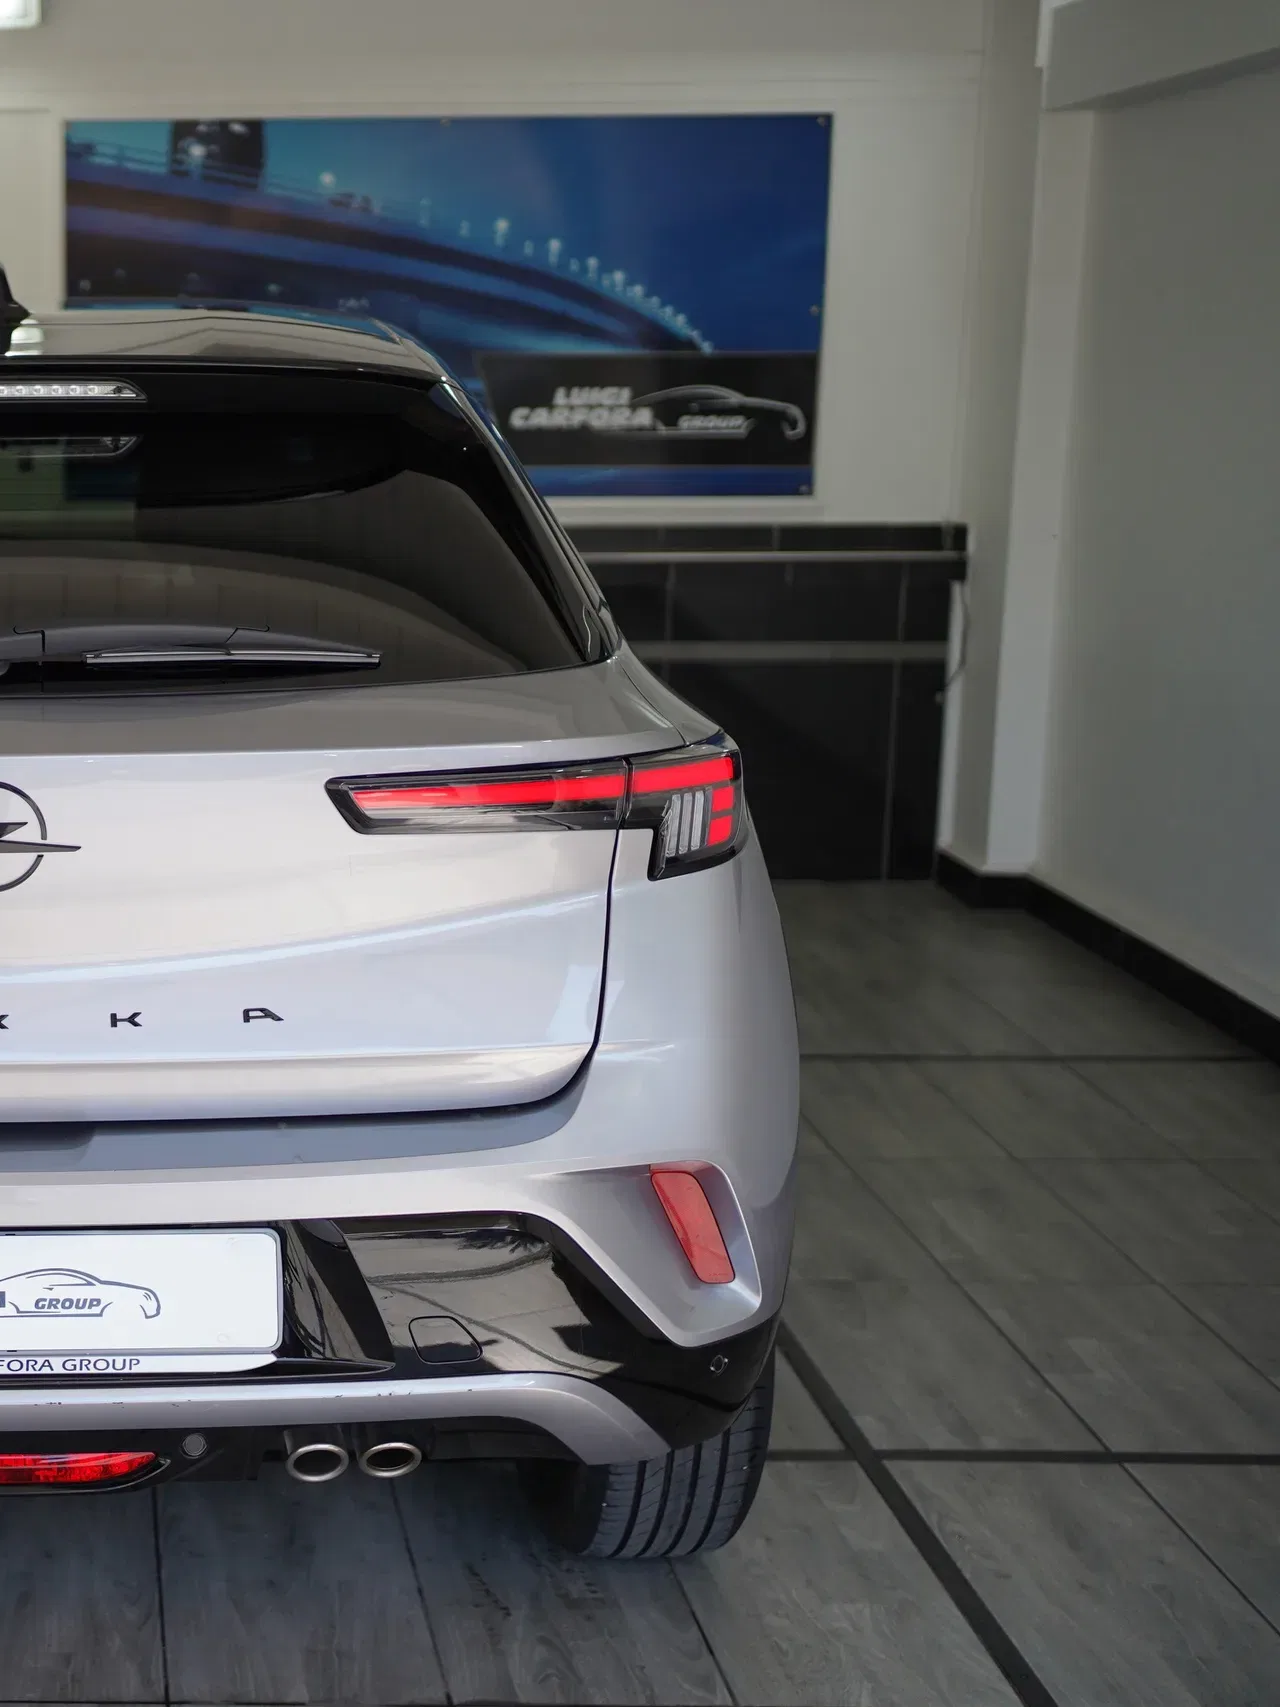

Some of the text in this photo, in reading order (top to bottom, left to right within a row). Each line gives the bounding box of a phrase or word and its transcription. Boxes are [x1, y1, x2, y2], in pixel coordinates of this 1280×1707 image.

[552, 386, 632, 405] LUIGI
[509, 407, 653, 430] CARFORA
[34, 1297, 102, 1310] GROUP
[61, 1358, 141, 1372] GROUP
